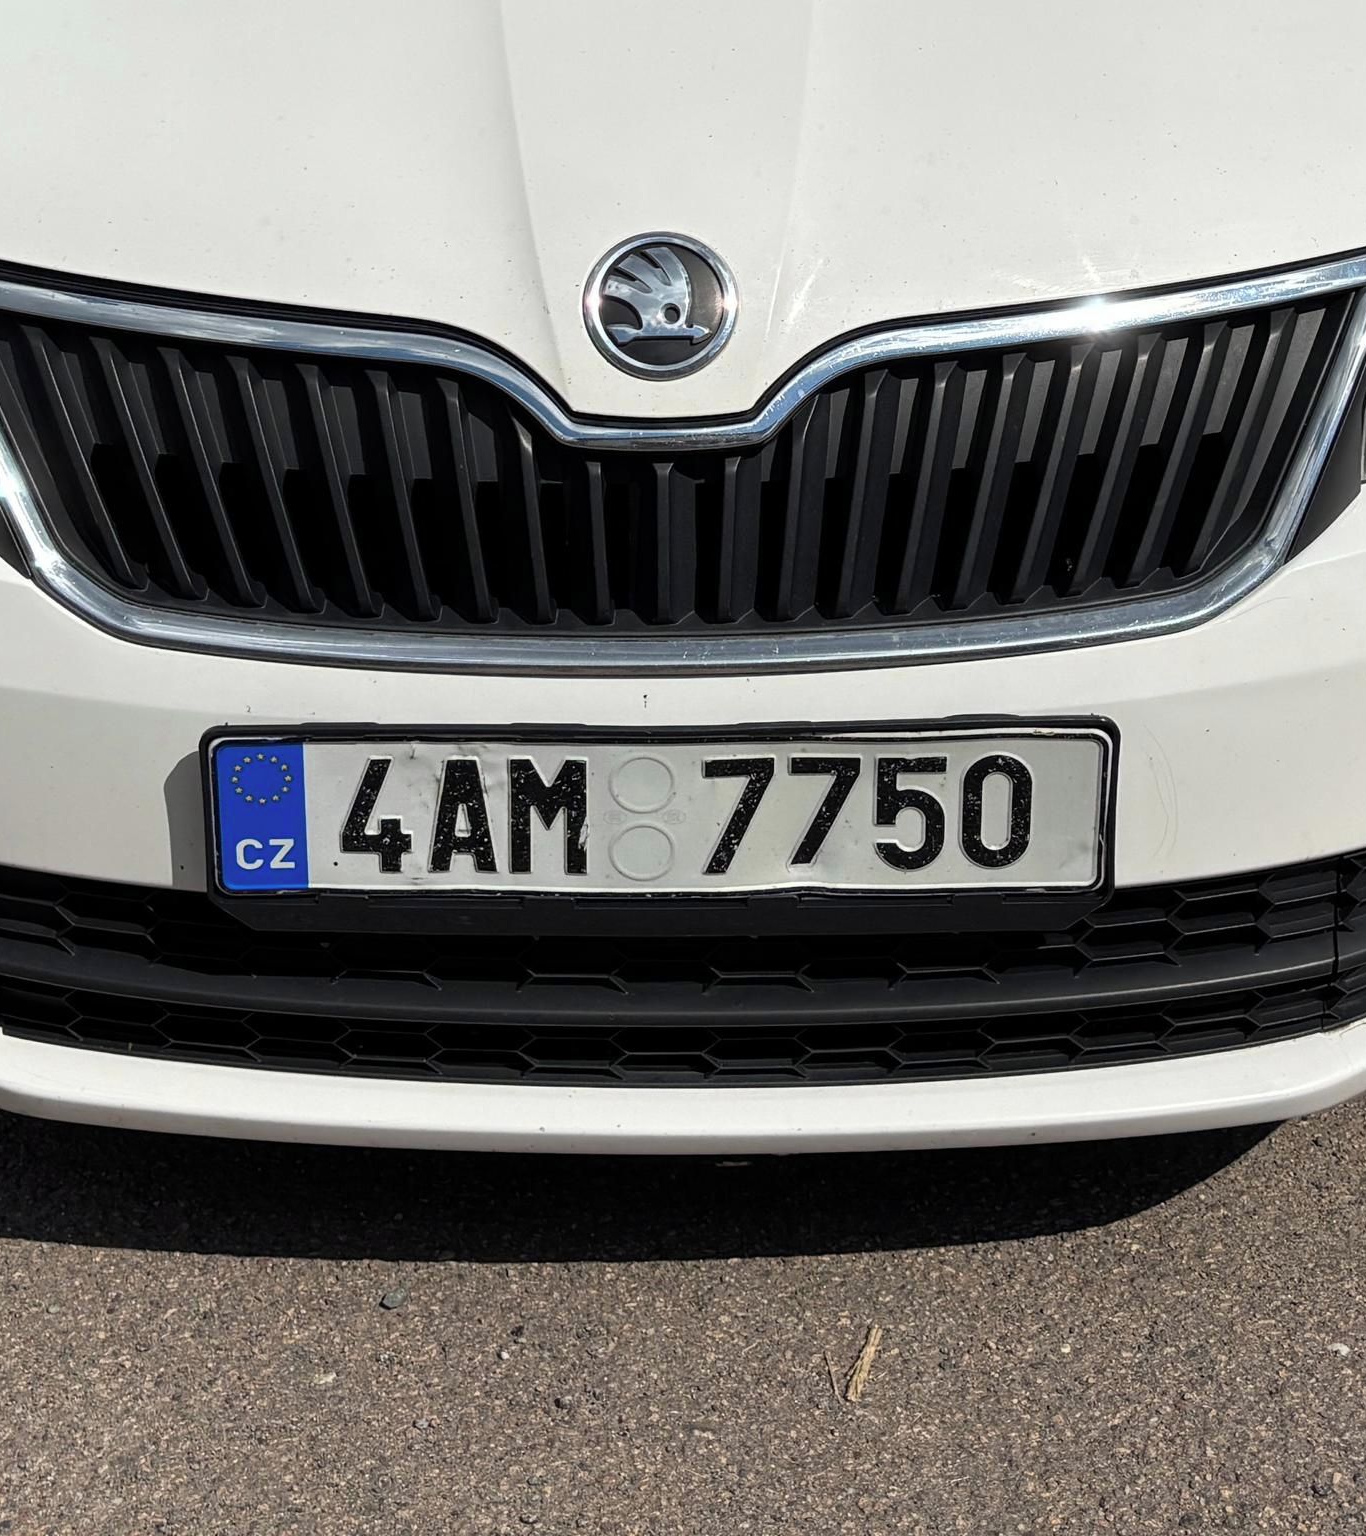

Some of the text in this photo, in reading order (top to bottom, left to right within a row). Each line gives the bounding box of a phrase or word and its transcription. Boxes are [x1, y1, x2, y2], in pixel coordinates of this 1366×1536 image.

[339, 754, 1033, 875] 4AM 7750
[235, 838, 296, 870] CZ
